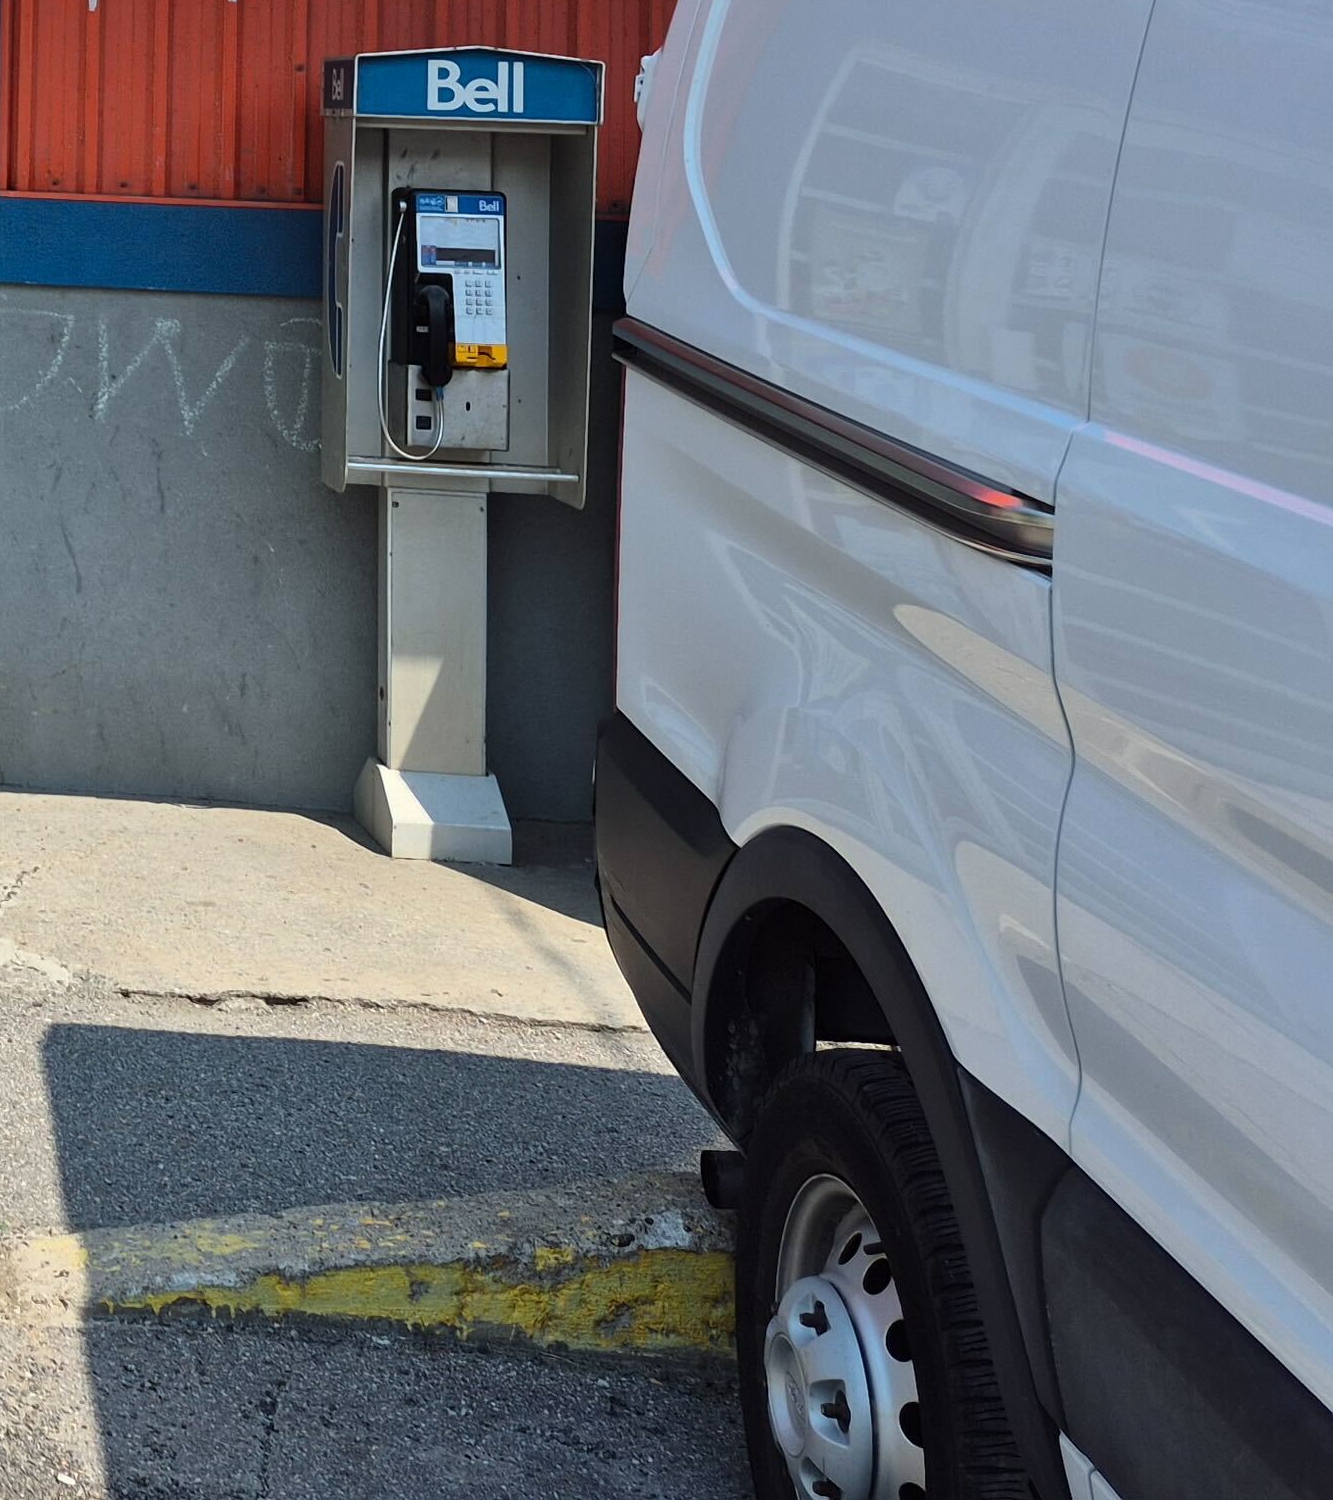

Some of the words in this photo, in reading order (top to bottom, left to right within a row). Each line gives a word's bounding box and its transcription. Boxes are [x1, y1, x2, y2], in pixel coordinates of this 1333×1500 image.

[331, 67, 345, 101] Bell
[426, 59, 525, 114] Bell
[478, 199, 500, 212] Bell
